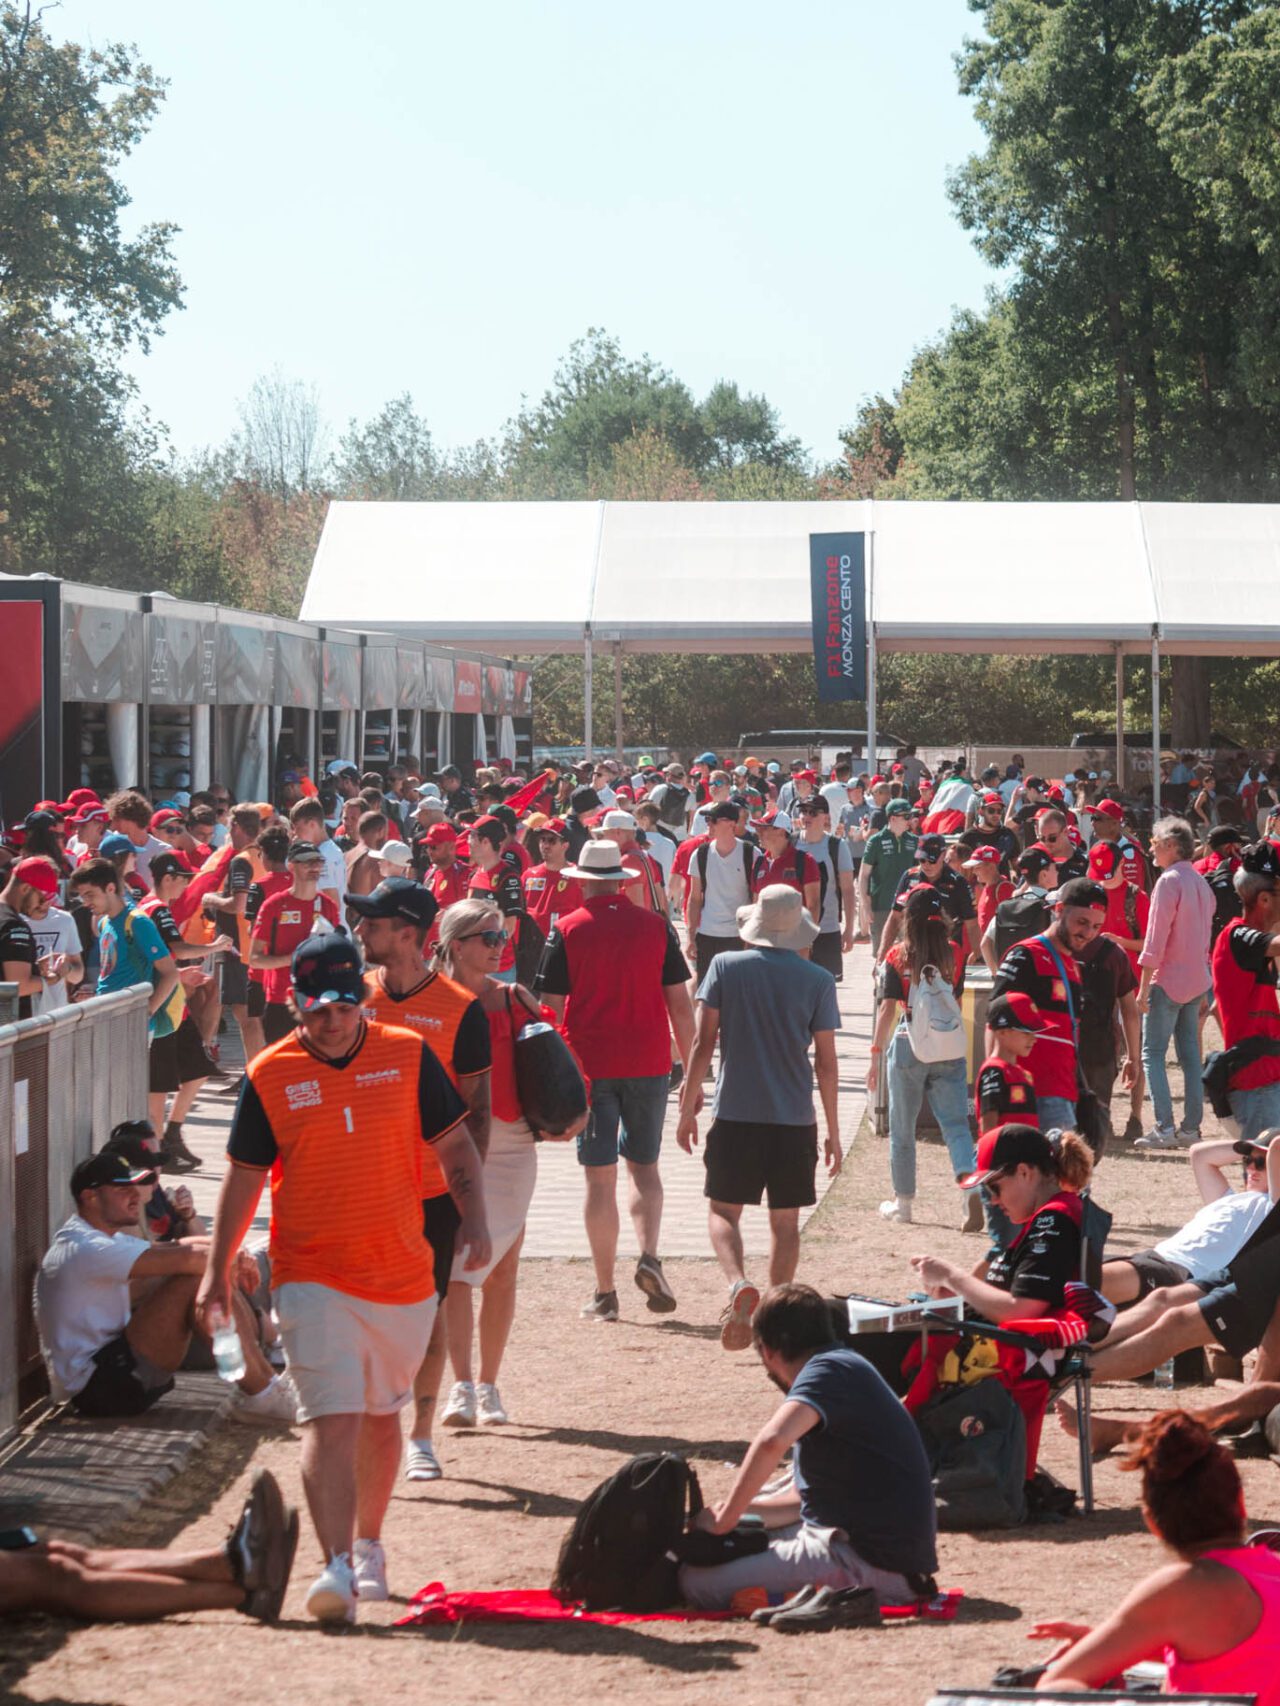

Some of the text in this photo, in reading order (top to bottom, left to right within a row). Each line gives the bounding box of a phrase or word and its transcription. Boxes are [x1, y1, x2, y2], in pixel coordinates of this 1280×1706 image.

[826, 555, 842, 677] F1 Fanzone
[840, 555, 853, 677] MONZA CENTO
[344, 1106, 354, 1133] 1
